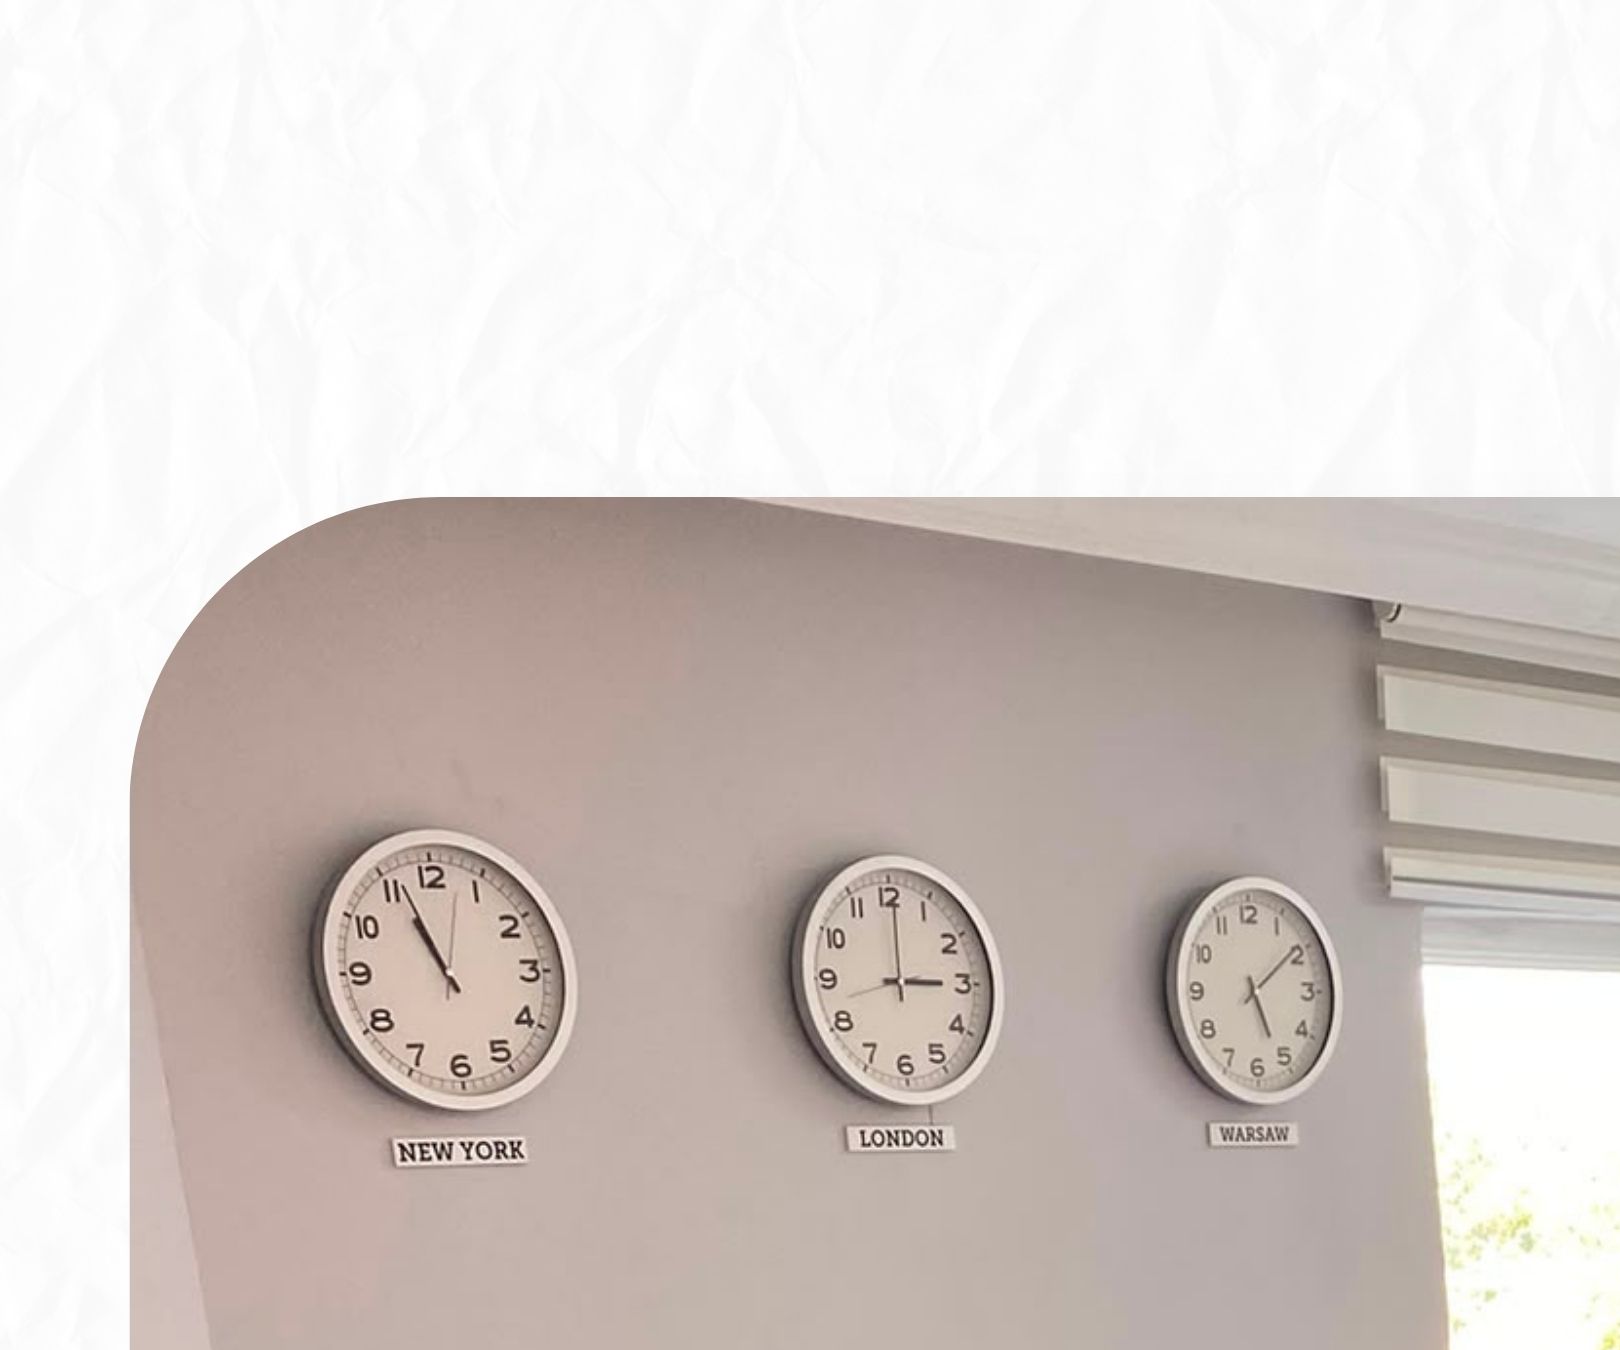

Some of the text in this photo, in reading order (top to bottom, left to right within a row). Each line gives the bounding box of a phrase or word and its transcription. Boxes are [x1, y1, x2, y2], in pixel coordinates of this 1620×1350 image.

[418, 866, 445, 888] 12
[383, 879, 400, 902] 11
[472, 880, 479, 902] 1
[878, 887, 900, 908] 12
[851, 897, 863, 918] 11
[921, 901, 926, 922] 1
[1239, 905, 1258, 924] 12
[356, 915, 379, 939] 10
[499, 915, 520, 938] 2
[1217, 916, 1228, 935] 11
[1274, 917, 1279, 936] 1
[826, 928, 846, 949] 10
[941, 933, 958, 954] 2
[1195, 944, 1212, 964] 10
[1290, 945, 1304, 965] 2
[349, 961, 372, 985] 9
[519, 959, 540, 982] 3
[819, 969, 837, 989] 9
[955, 974, 972, 994] 3
[1190, 981, 1204, 1001] 9
[1301, 982, 1314, 1001] 3
[370, 1009, 394, 1032] 8
[515, 1005, 535, 1028] 4
[834, 1010, 853, 1032] 8
[949, 1014, 965, 1034] 4
[1200, 1019, 1216, 1039] 8
[1295, 1020, 1309, 1038] 4
[406, 1044, 424, 1066] 7
[489, 1040, 512, 1062] 5
[862, 1043, 877, 1064] 7
[929, 1043, 946, 1064] 5
[1223, 1048, 1234, 1067] 7
[1277, 1047, 1291, 1066] 5
[450, 1055, 471, 1078] 6
[897, 1055, 914, 1076] 6
[1250, 1058, 1264, 1077] 6
[860, 1130, 944, 1147] LONDON
[1220, 1126, 1289, 1142] WARSAW
[397, 1140, 525, 1163] NEW YORK
